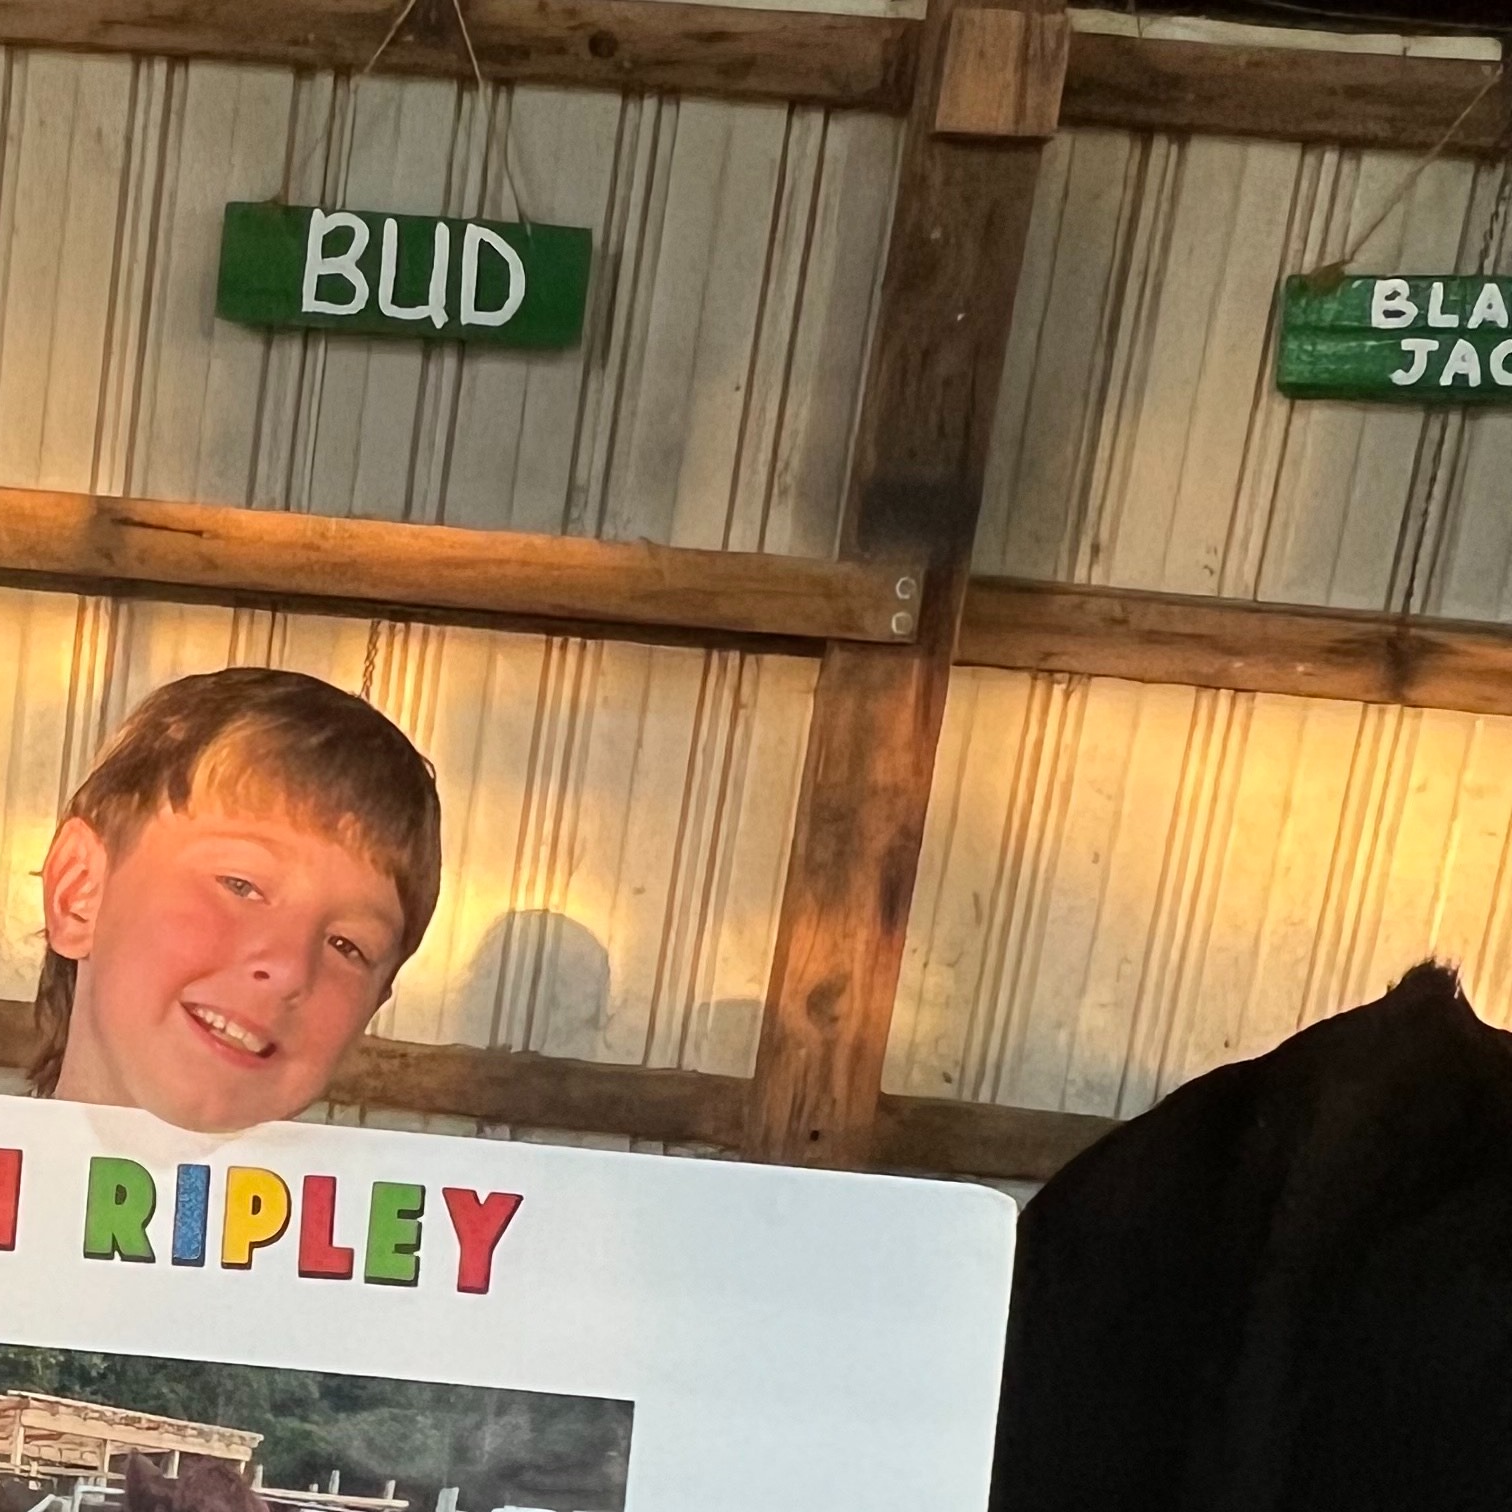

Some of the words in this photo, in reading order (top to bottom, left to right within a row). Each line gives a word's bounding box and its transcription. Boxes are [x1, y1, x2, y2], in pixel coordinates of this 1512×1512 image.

[302, 208, 525, 329] BUD
[1371, 279, 1509, 329] BLA
[83, 1156, 525, 1294] RIPLEY
